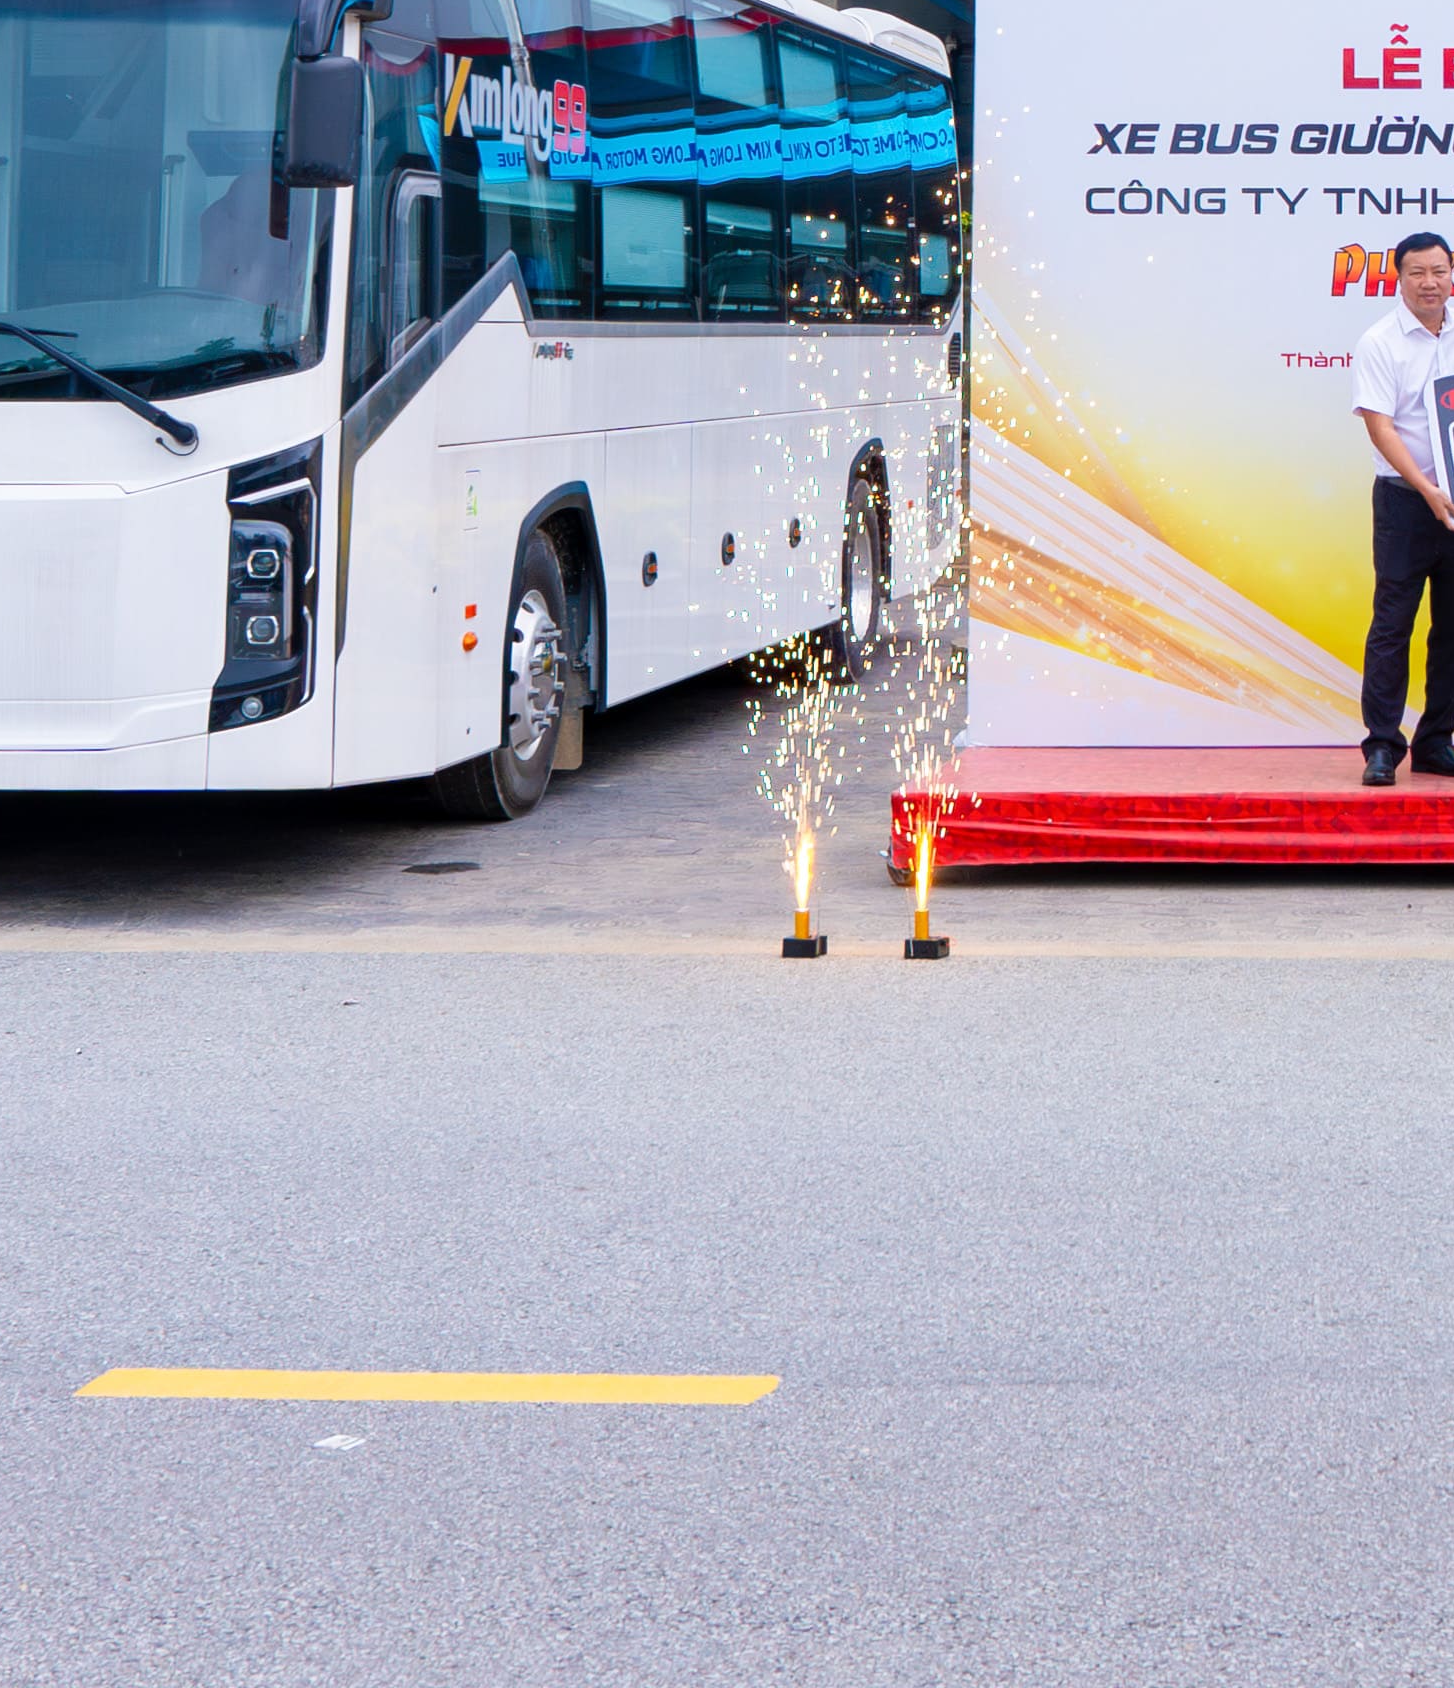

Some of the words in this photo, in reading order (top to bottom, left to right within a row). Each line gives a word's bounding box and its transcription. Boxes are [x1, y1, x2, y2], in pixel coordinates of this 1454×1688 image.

[1342, 23, 1422, 89] LỄ
[444, 52, 587, 162] KimLong99
[1087, 123, 1160, 155] XE
[1168, 123, 1279, 155] BUS
[1085, 179, 1226, 215] CÔNG
[1241, 187, 1309, 215] TY
